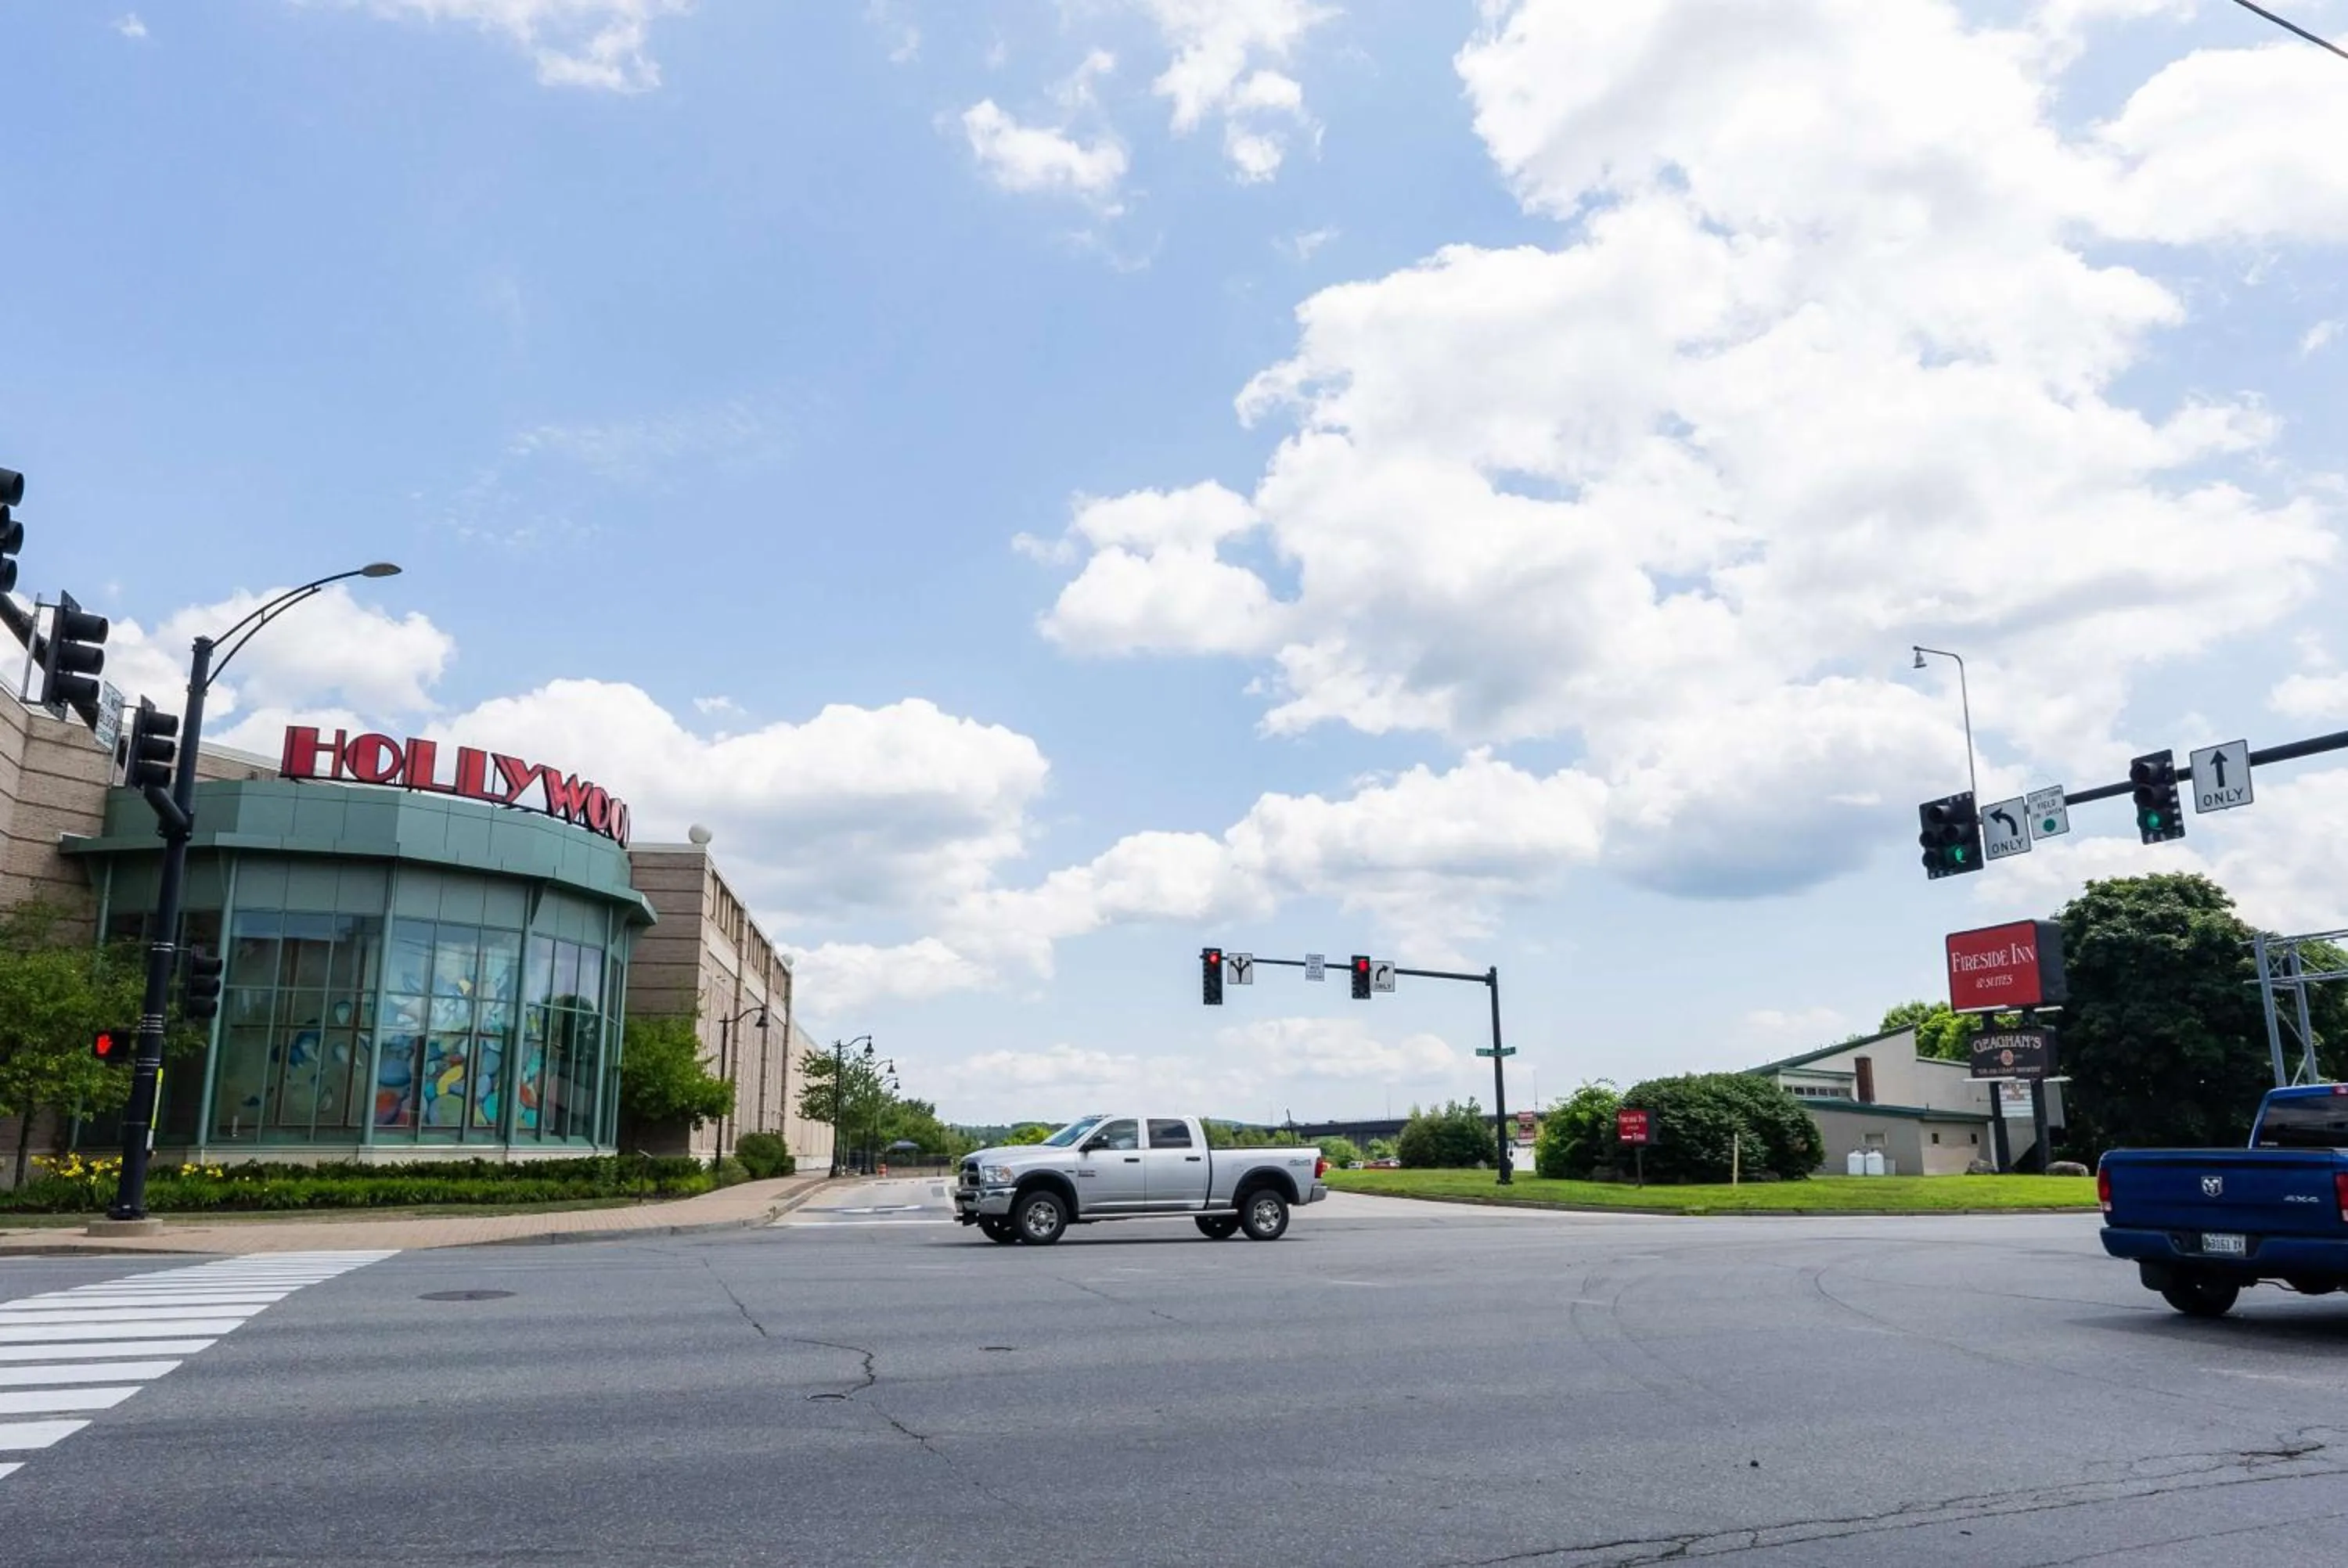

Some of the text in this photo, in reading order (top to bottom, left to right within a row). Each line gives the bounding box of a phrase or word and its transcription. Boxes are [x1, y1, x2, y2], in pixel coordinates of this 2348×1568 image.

[281, 725, 629, 847] HOLLYWOO
[2202, 787, 2243, 807] ONLY
[1992, 838, 2023, 854] ONLY
